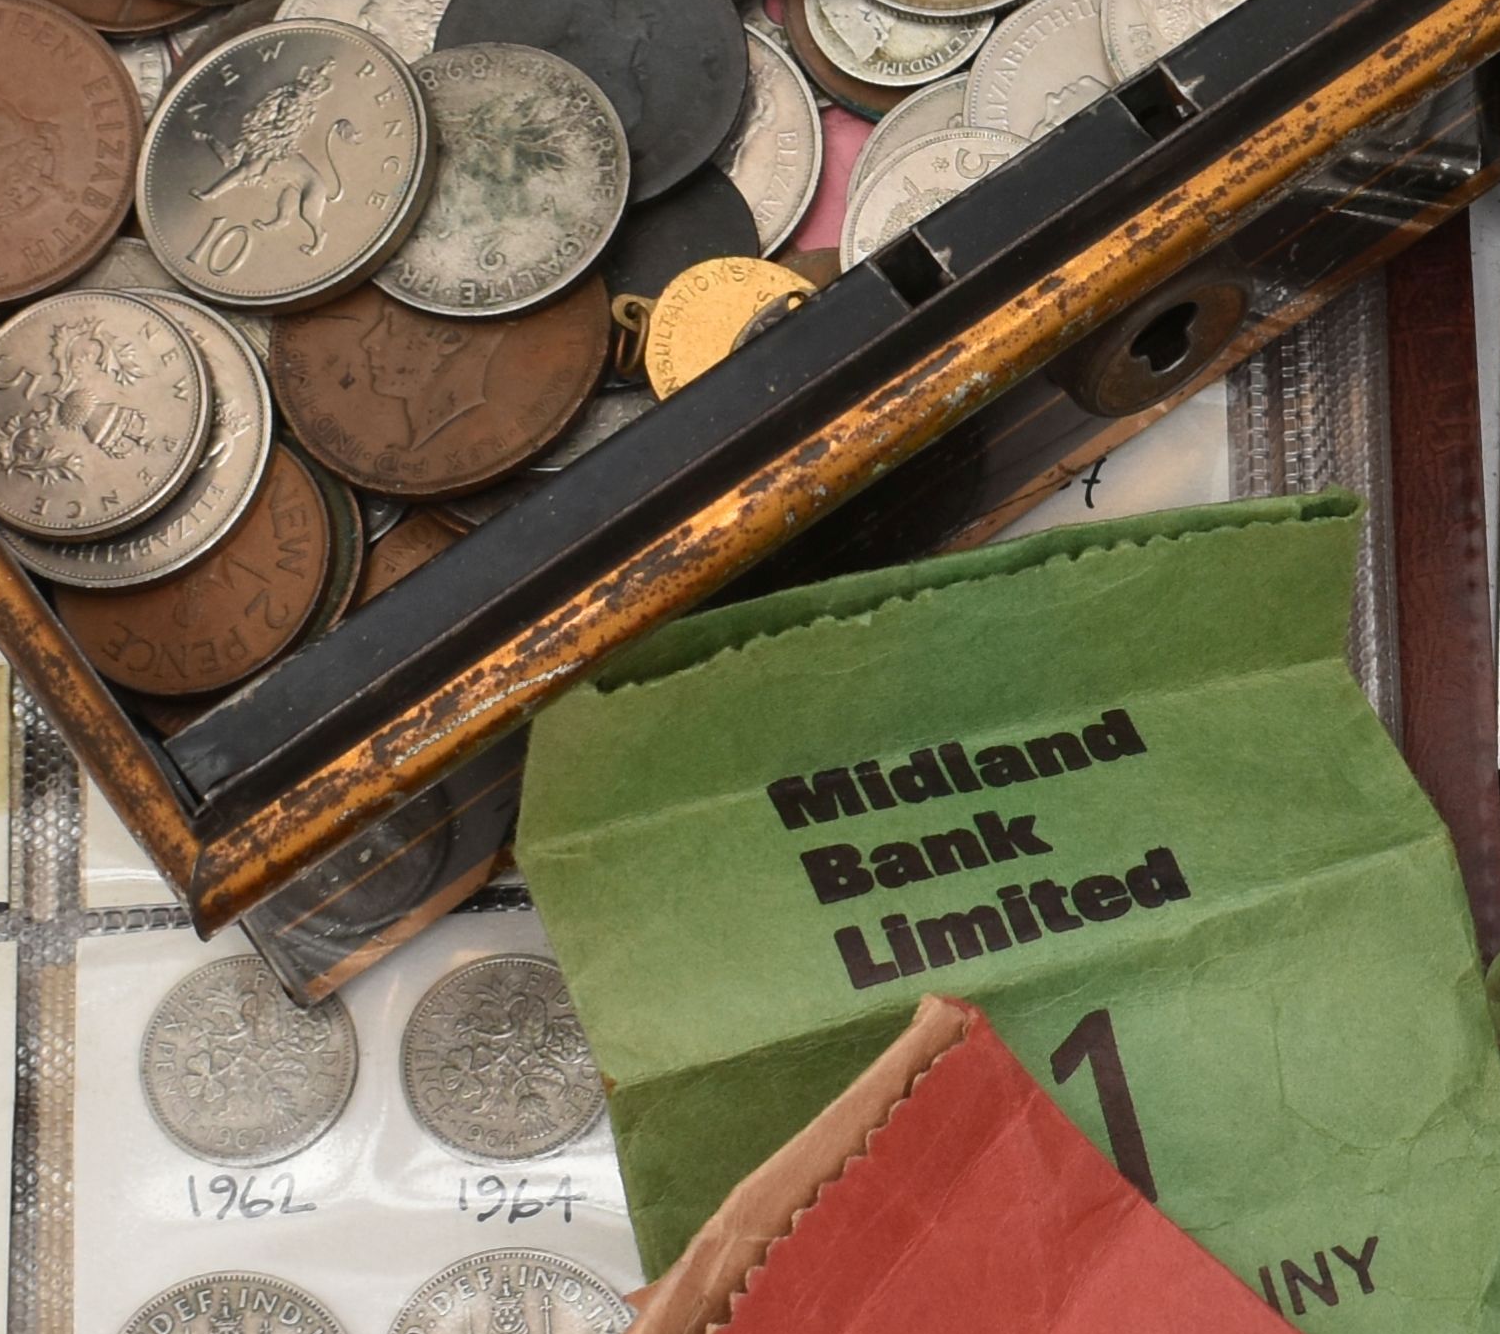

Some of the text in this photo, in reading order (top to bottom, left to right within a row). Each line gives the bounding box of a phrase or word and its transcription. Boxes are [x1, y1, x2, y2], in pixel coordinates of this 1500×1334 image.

[185, 39, 405, 212] NEW PENCE
[24, 74, 127, 273] ELIZABETH
[185, 214, 255, 278] 10
[138, 322, 191, 405] NEW
[31, 432, 181, 522] PENCE
[767, 708, 1149, 831] Midland
[799, 810, 1053, 906] Bank
[834, 847, 1192, 990] Limited
[188, 1176, 316, 1218] 1962
[460, 1176, 587, 1224] 1964
